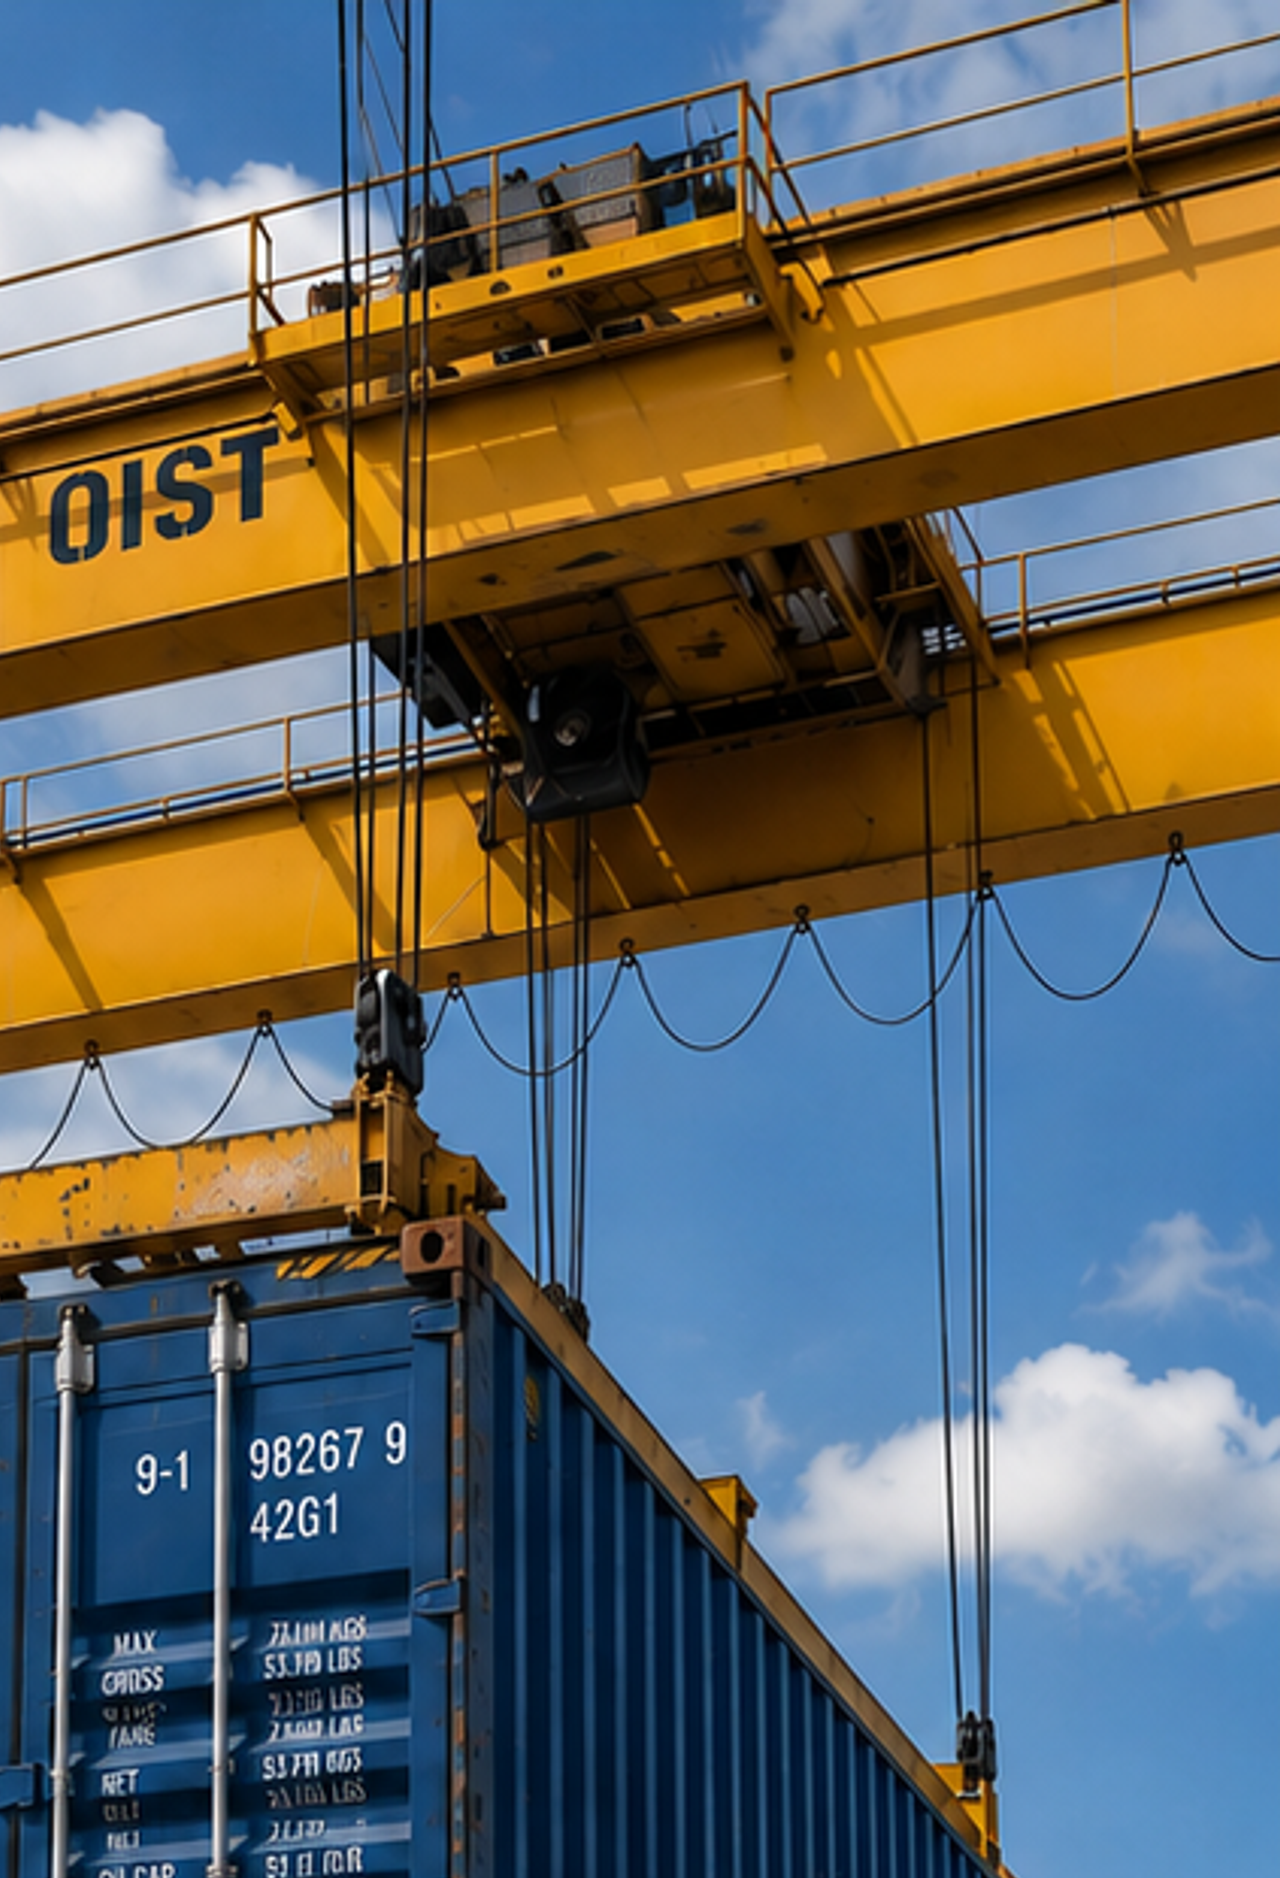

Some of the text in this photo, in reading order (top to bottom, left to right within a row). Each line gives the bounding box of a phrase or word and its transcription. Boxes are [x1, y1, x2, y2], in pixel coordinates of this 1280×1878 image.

[49, 426, 280, 565] OIST
[135, 1420, 407, 1495] 9-1 98267 9
[250, 1491, 338, 1543] 42G1
